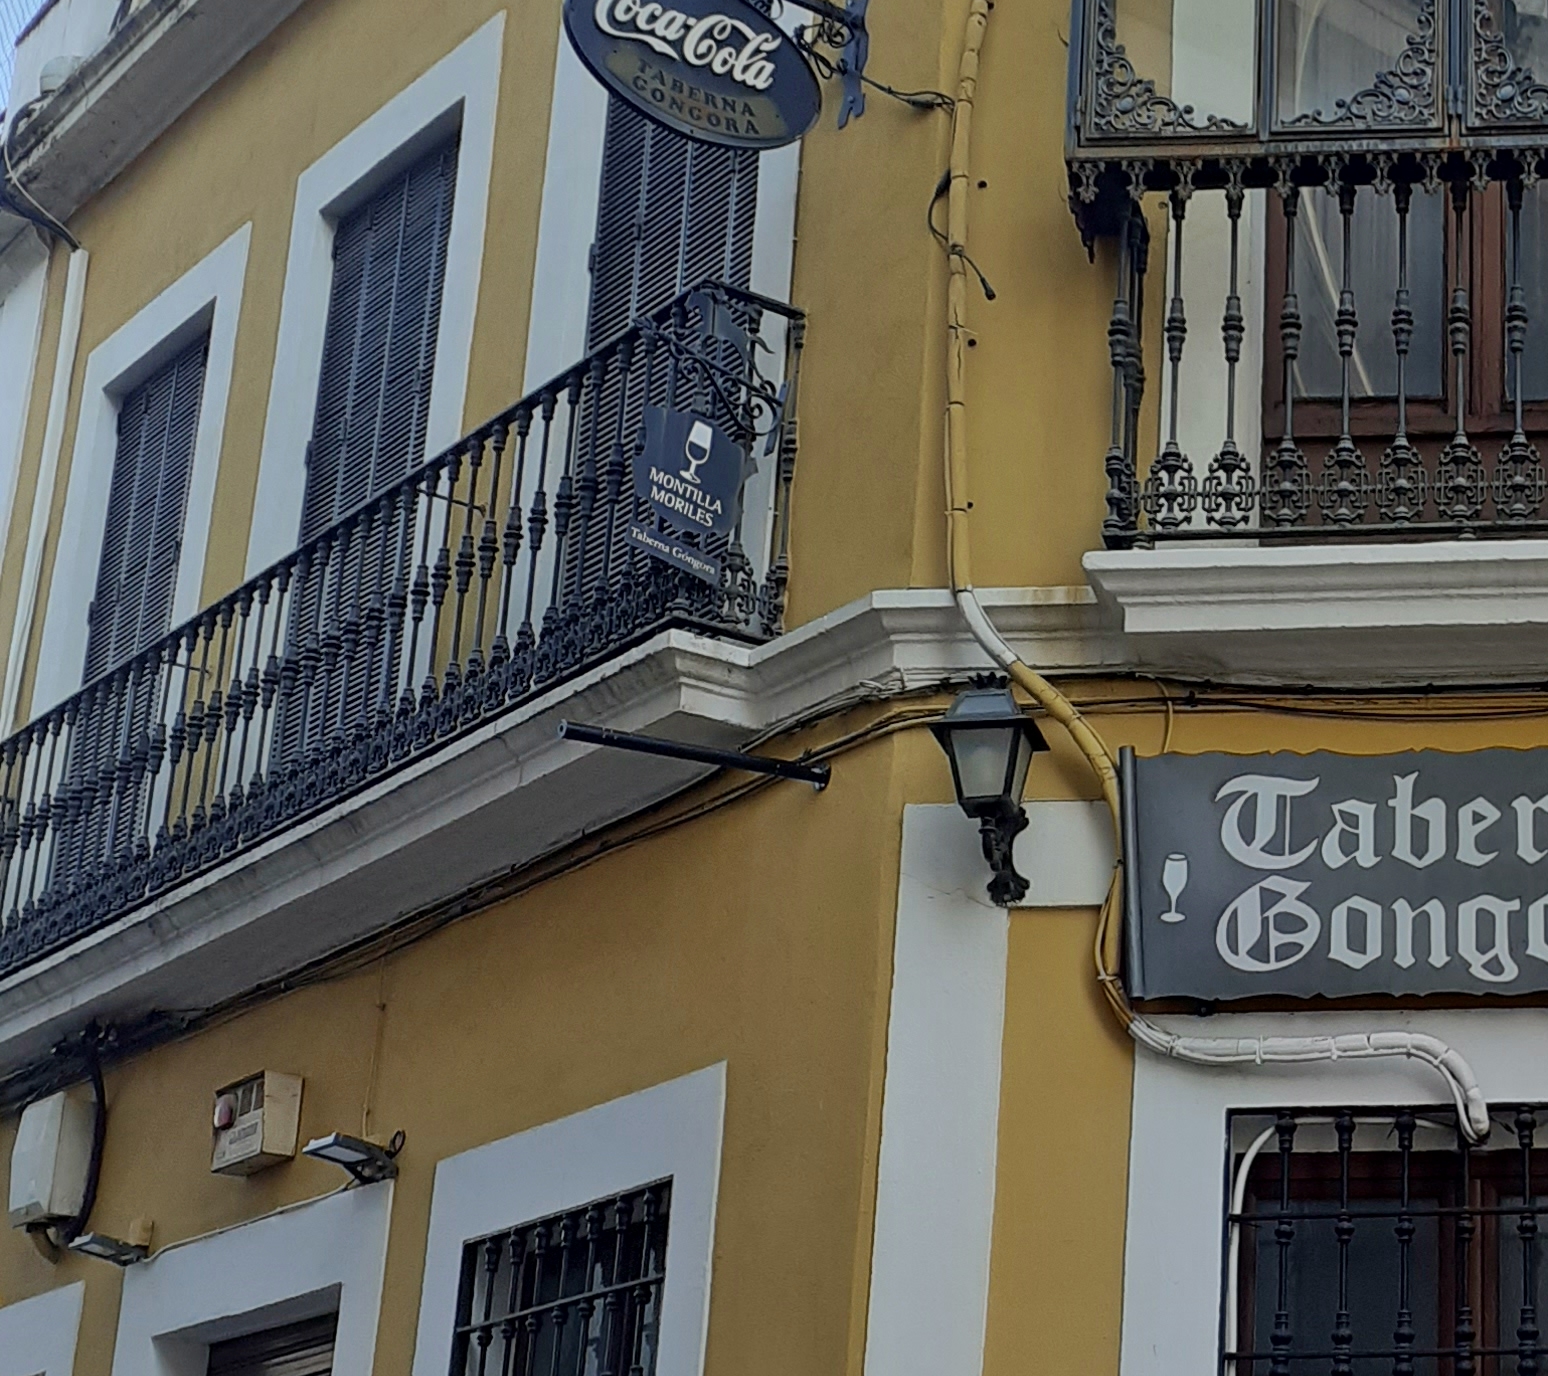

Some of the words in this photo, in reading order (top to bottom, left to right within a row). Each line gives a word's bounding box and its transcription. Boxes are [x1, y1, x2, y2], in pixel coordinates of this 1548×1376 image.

[632, 74, 760, 135] GONGORA
[637, 58, 756, 117] TABERNA
[649, 466, 722, 515] MONTILLA
[650, 485, 714, 527] MORILES
[631, 526, 670, 554] Taberna
